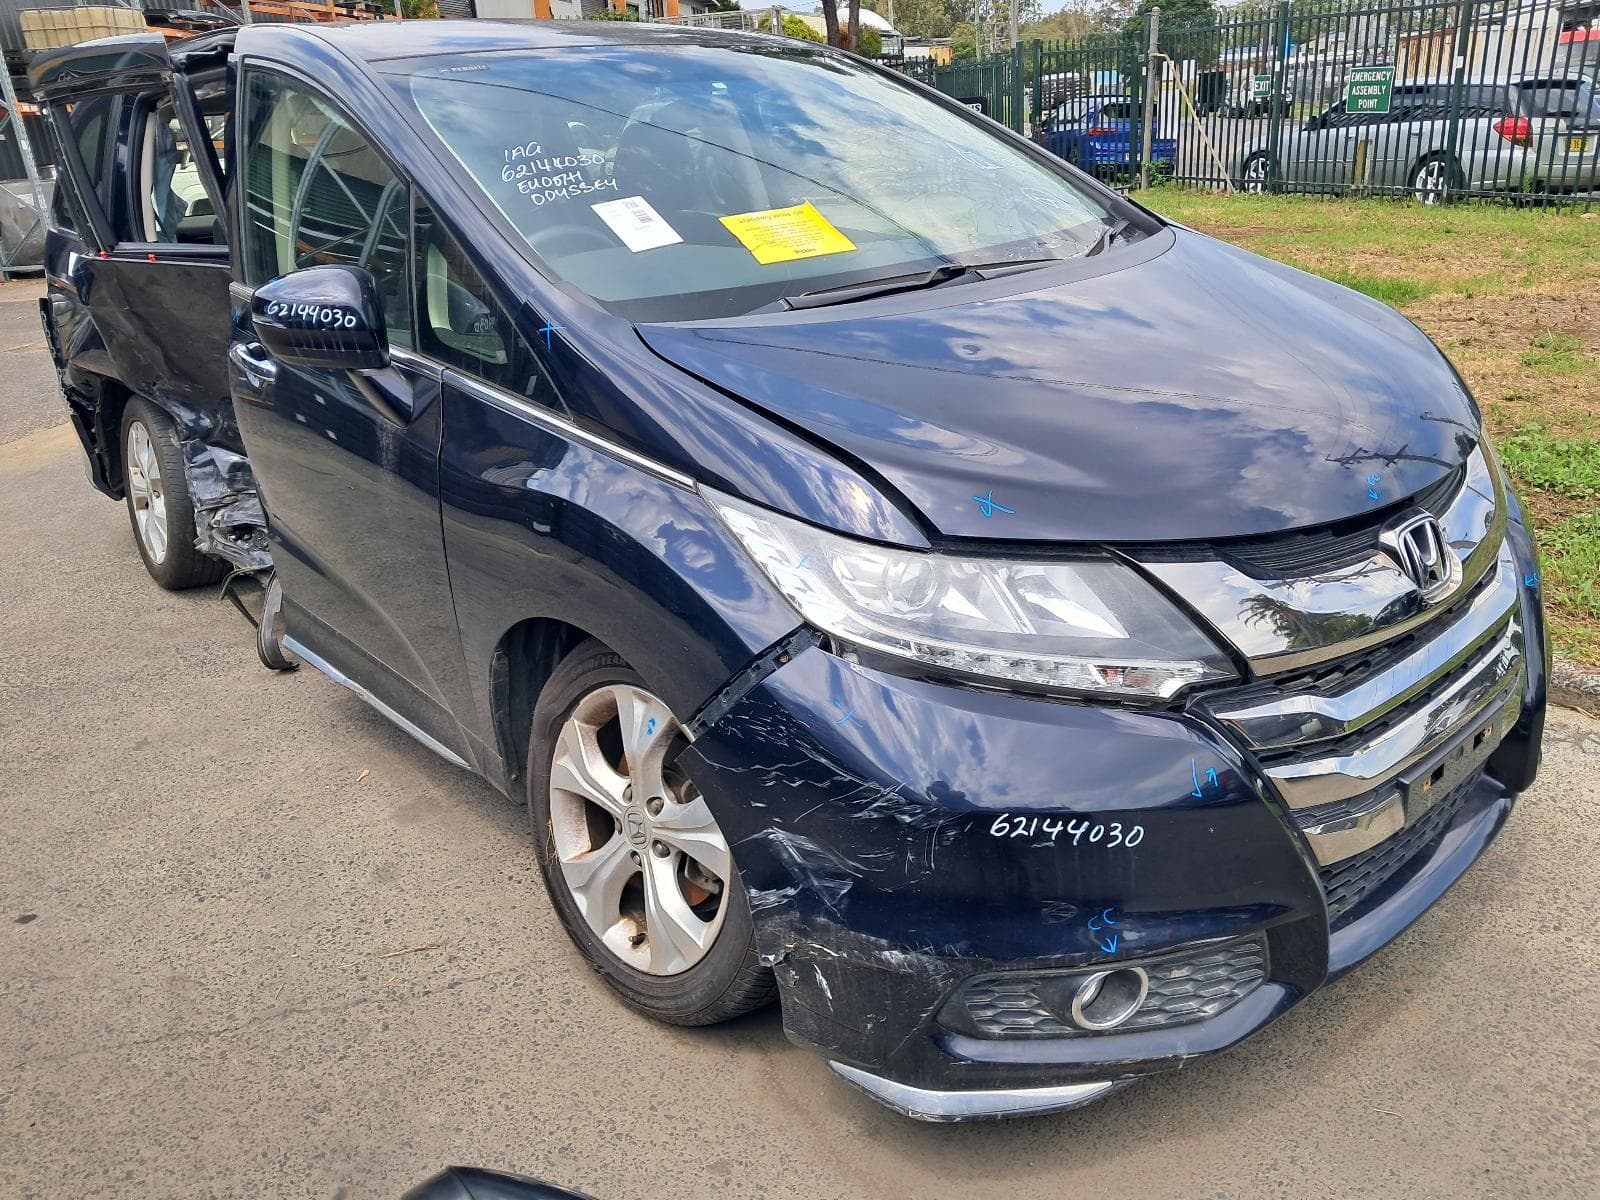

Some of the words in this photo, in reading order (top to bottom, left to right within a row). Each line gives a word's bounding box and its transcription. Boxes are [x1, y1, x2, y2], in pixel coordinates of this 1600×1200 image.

[1351, 70, 1392, 82] EMERGENCY
[1255, 80, 1269, 92] EXIT
[1351, 85, 1387, 95] ASSEMBLY
[1358, 99, 1378, 109] POINT
[501, 153, 605, 182] 62144030
[531, 178, 619, 205] ODYSSEY
[267, 300, 357, 328] 62144030
[989, 813, 1145, 848] 62144030
